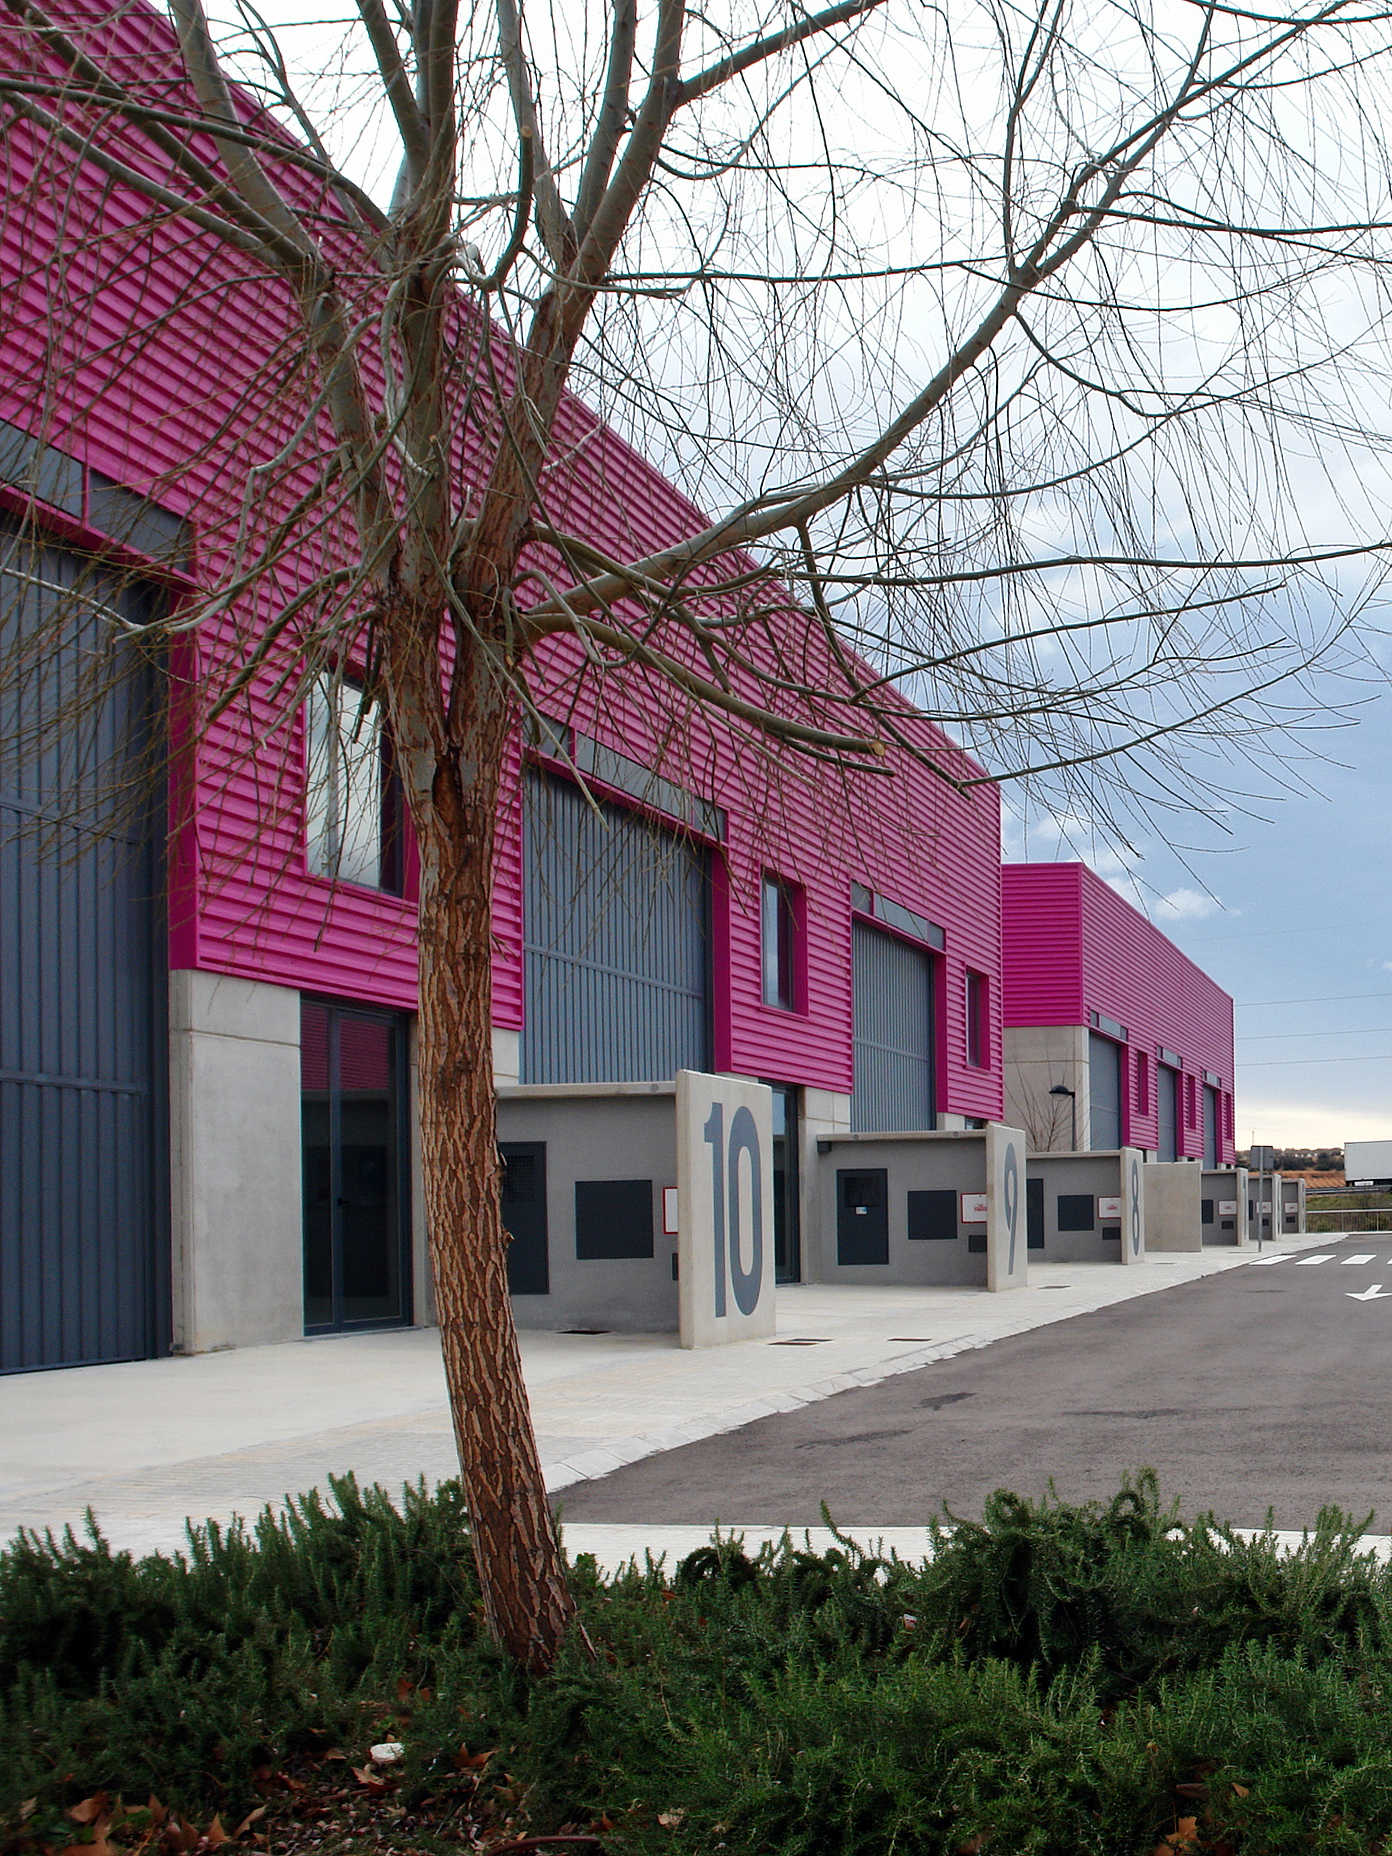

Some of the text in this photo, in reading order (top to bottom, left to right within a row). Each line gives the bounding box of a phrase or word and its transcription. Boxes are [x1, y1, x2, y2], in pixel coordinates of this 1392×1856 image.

[703, 1102, 763, 1318] 10
[1003, 1142, 1018, 1275] 9
[1132, 1158, 1140, 1256] 8
